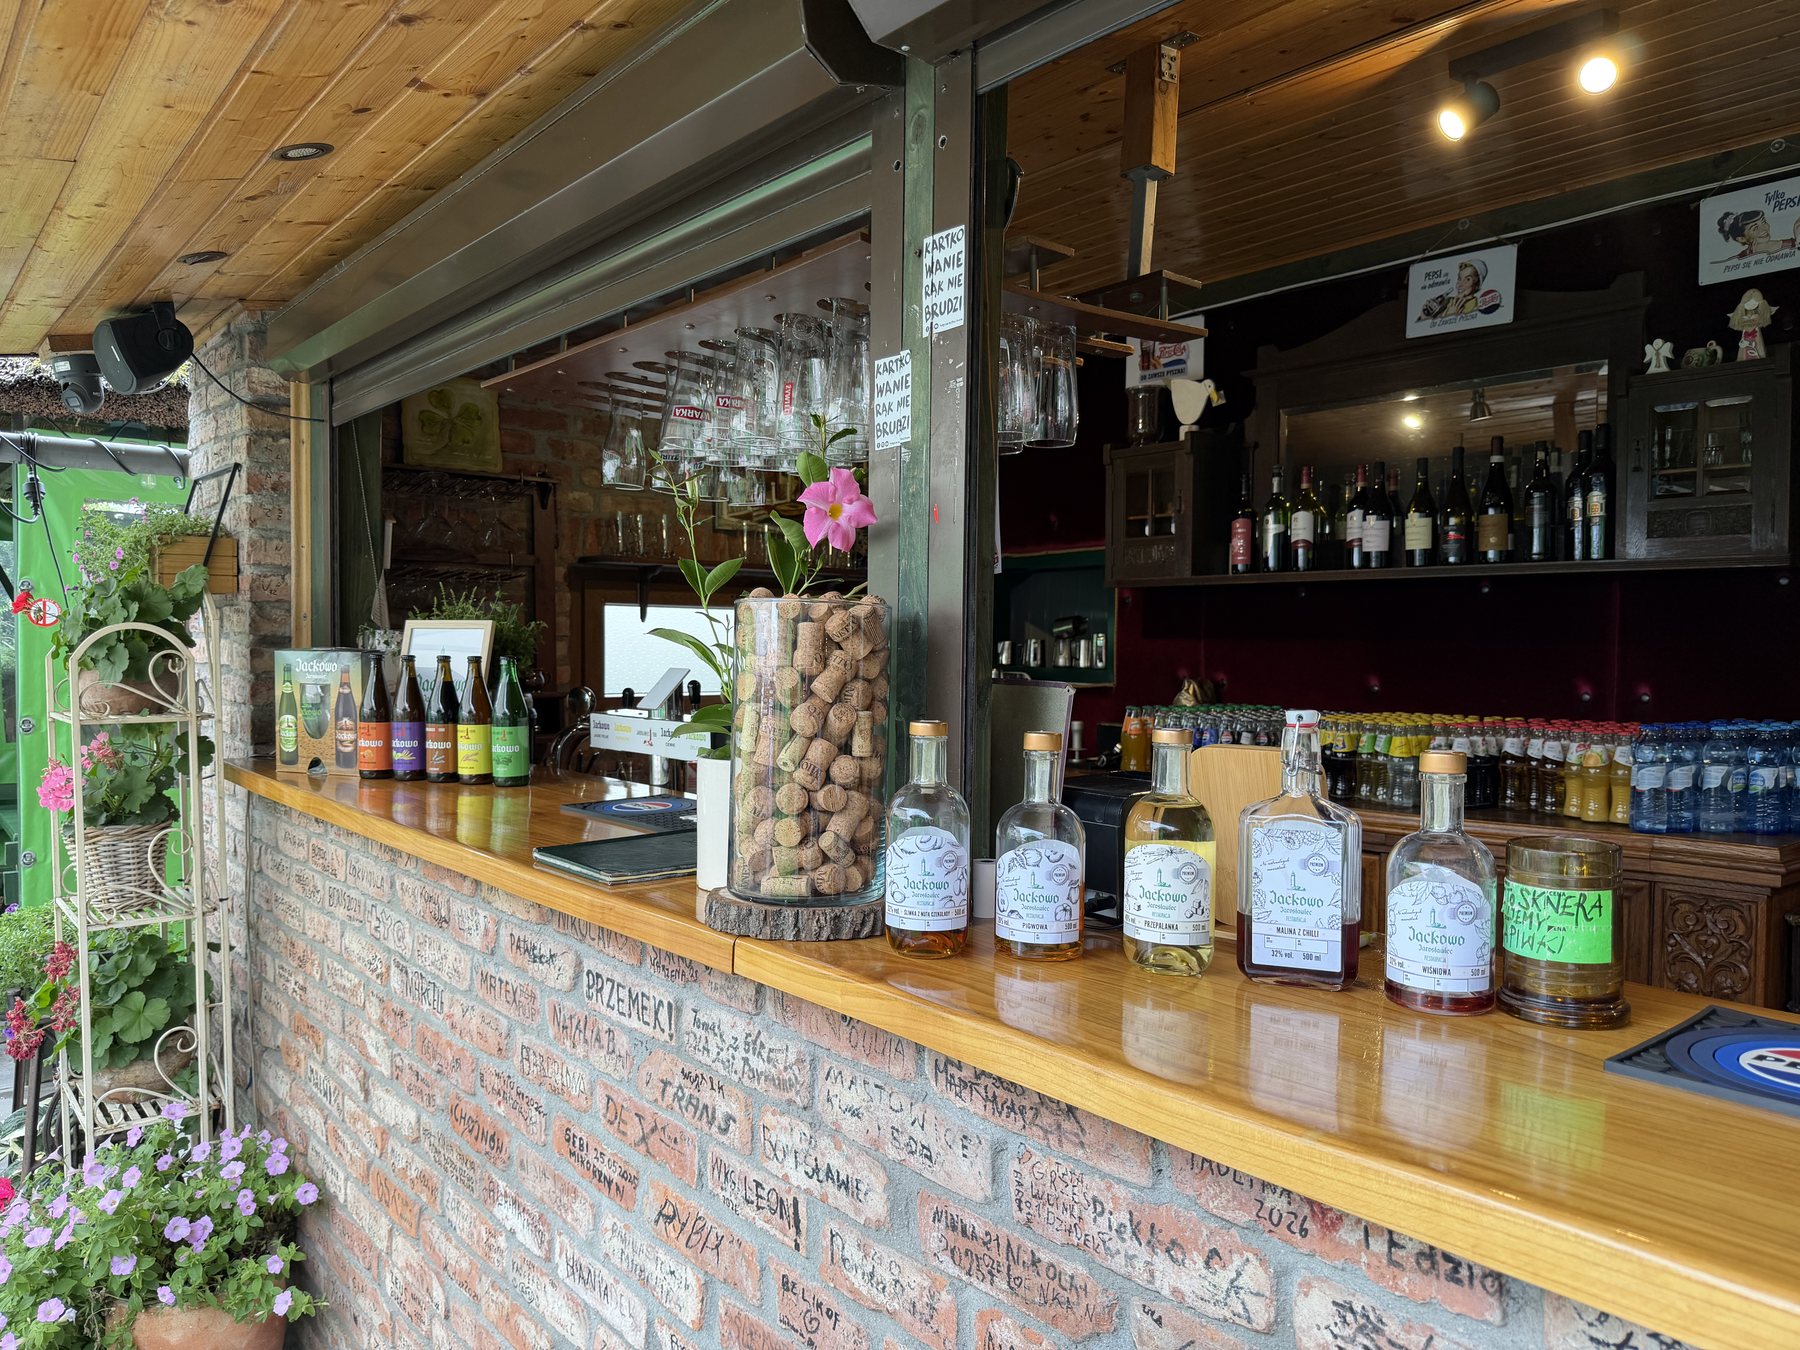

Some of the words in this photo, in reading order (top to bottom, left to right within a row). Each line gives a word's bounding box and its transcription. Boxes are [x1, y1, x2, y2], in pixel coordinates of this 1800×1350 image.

[1765, 190, 1785, 205] Tylko
[924, 228, 965, 259] KARTKO
[924, 251, 964, 279] WANIE
[1723, 263, 1741, 274] PEPSI
[1753, 258, 1764, 267] NIE
[1765, 250, 1796, 264] ODMAWIA
[947, 273, 964, 291] NIE
[1424, 269, 1442, 281] PEPSI
[924, 295, 963, 323] BRUDZI
[875, 353, 911, 379] KARTKO
[876, 373, 910, 399] WANIE
[896, 394, 910, 412] NIE
[875, 415, 910, 440] BRUDZI
[296, 659, 338, 673] Jackowo
[904, 876, 949, 891] Jackowo
[1013, 888, 1059, 904] Jackowo
[1139, 885, 1188, 903] Jackowo
[1269, 890, 1324, 908] Jackowo
[1518, 887, 1604, 927] SKNERA
[1192, 924, 1200, 932] 500
[1276, 926, 1297, 934] MALINA
[1302, 928, 1319, 938] CHILLI
[1408, 926, 1466, 946] Jackowo
[1302, 952, 1313, 960] 500
[1314, 953, 1321, 961] ml
[1422, 965, 1452, 977] WIŚNIOWA
[1470, 968, 1480, 977] 500
[1254, 1198, 1309, 1239] 2026
